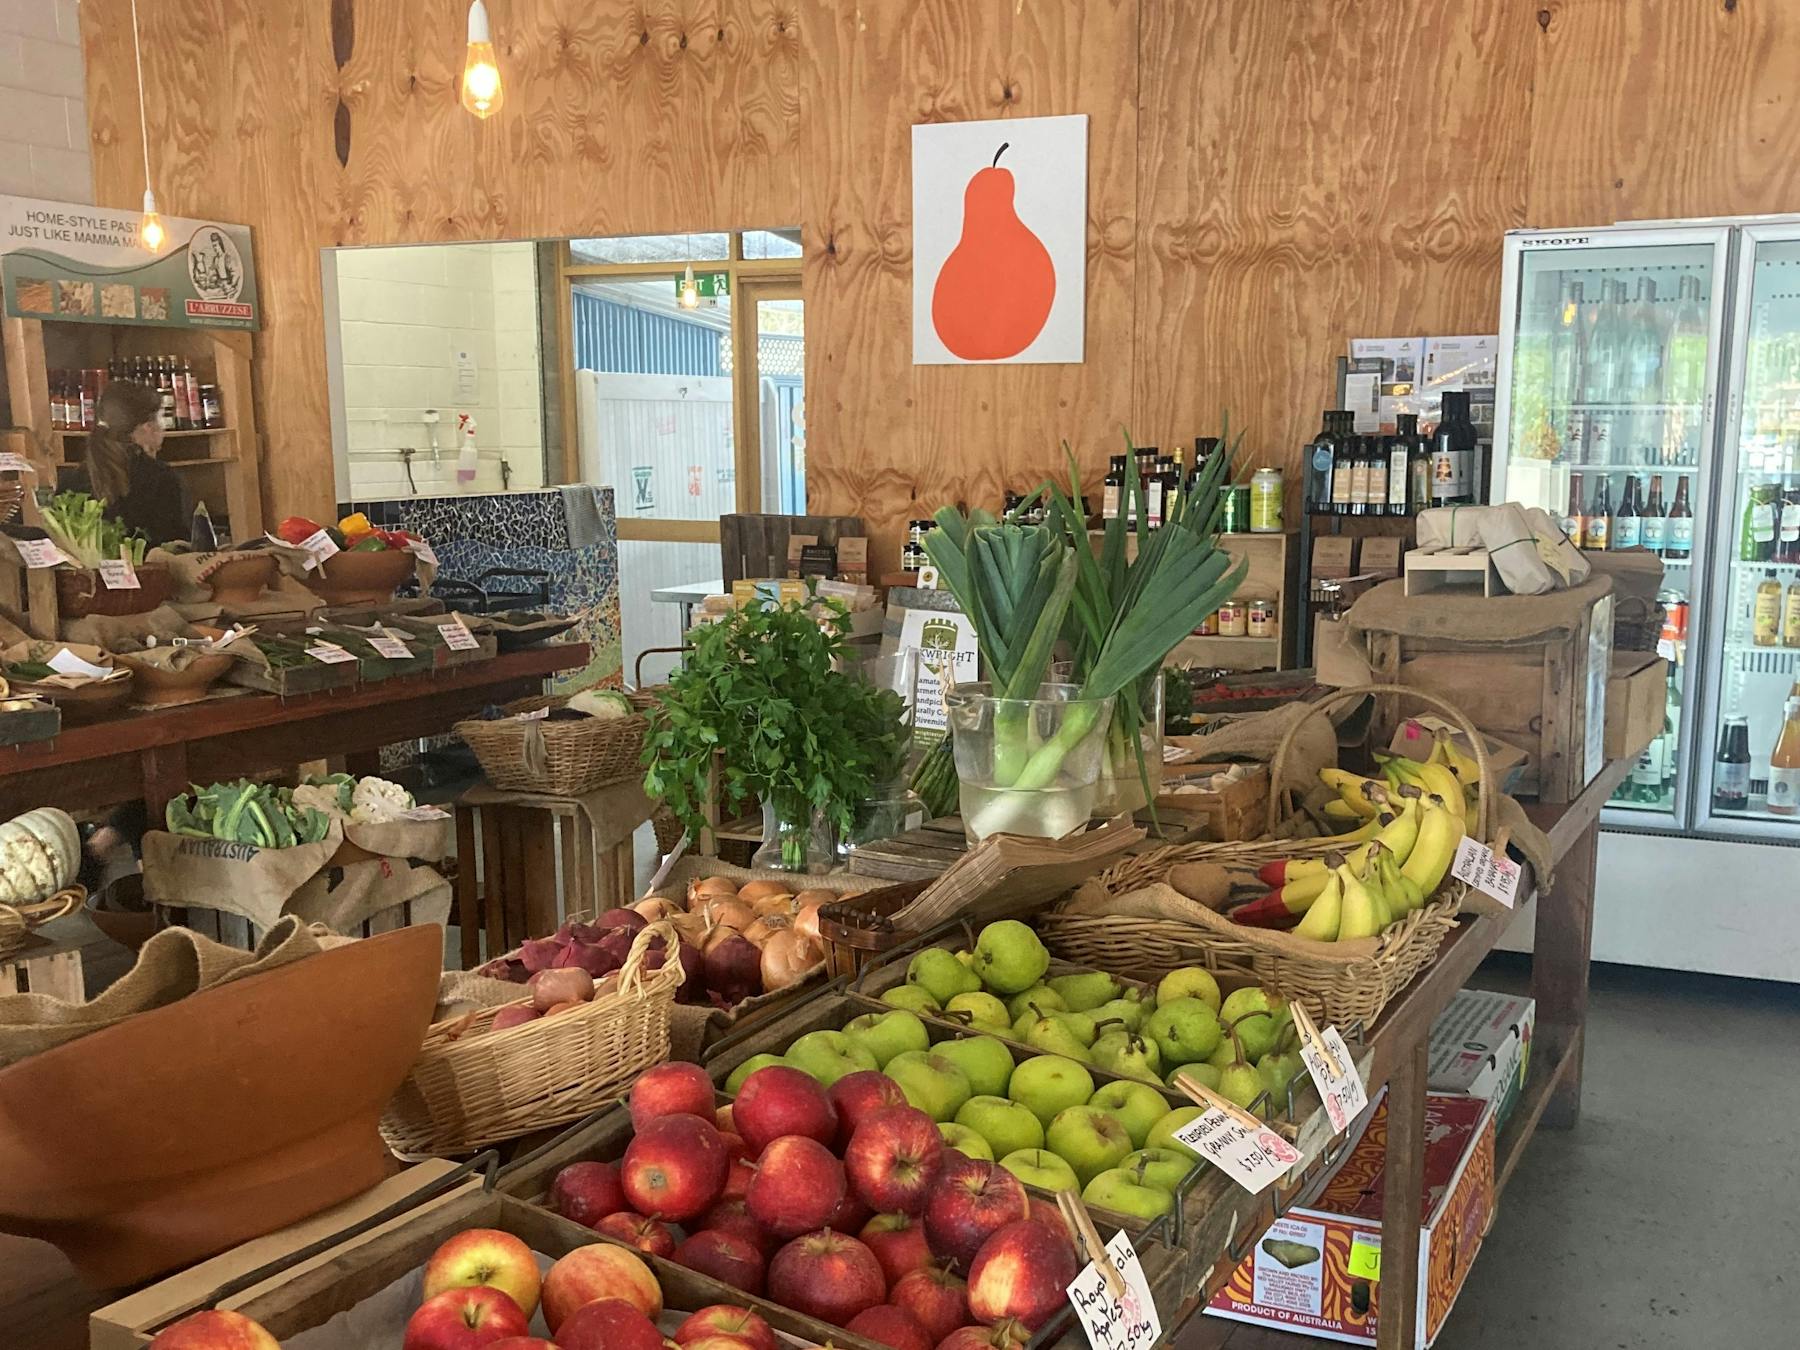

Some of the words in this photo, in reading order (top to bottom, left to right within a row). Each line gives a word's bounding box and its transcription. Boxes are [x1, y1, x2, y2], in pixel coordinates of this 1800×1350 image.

[26, 211, 107, 230] HOME-STYLE
[110, 219, 139, 233] PAST
[8, 225, 40, 239] JUST
[43, 230, 71, 242] LIKE
[74, 232, 121, 247] MAMMA
[680, 279, 704, 291] EIT
[1203, 1130, 1237, 1159] GRANNY
[1091, 1298, 1123, 1346] Apples
[1231, 1301, 1275, 1319] PRODUCT
[1277, 1310, 1291, 1320] OF
[1292, 1314, 1343, 1330] AUSTRALIA
